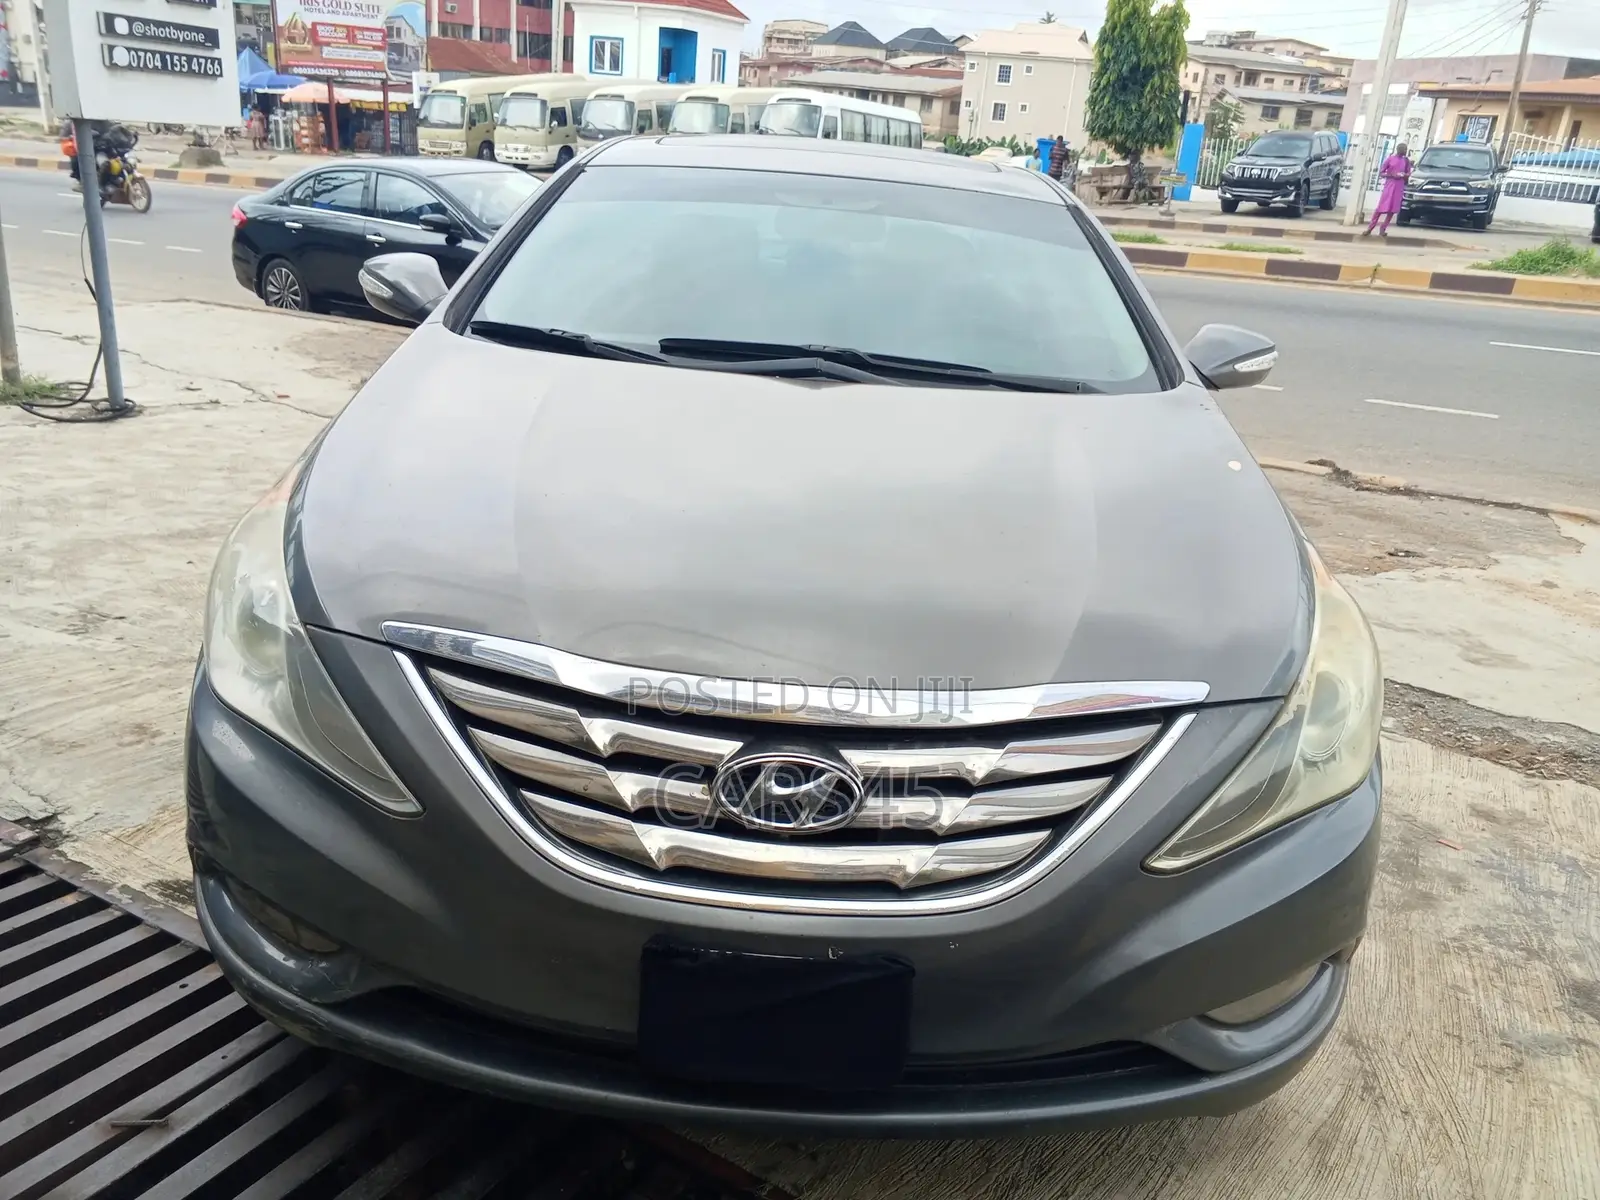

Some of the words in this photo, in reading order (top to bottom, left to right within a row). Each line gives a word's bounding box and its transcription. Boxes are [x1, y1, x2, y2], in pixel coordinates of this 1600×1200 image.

[322, 0, 352, 11] GOLD
[354, 2, 382, 14] SUITE
[342, 10, 379, 19] APARTMENT
[132, 21, 212, 46] @shotbyone_
[130, 50, 162, 69] 0704
[165, 54, 188, 72] 155
[191, 57, 221, 75] 4766
